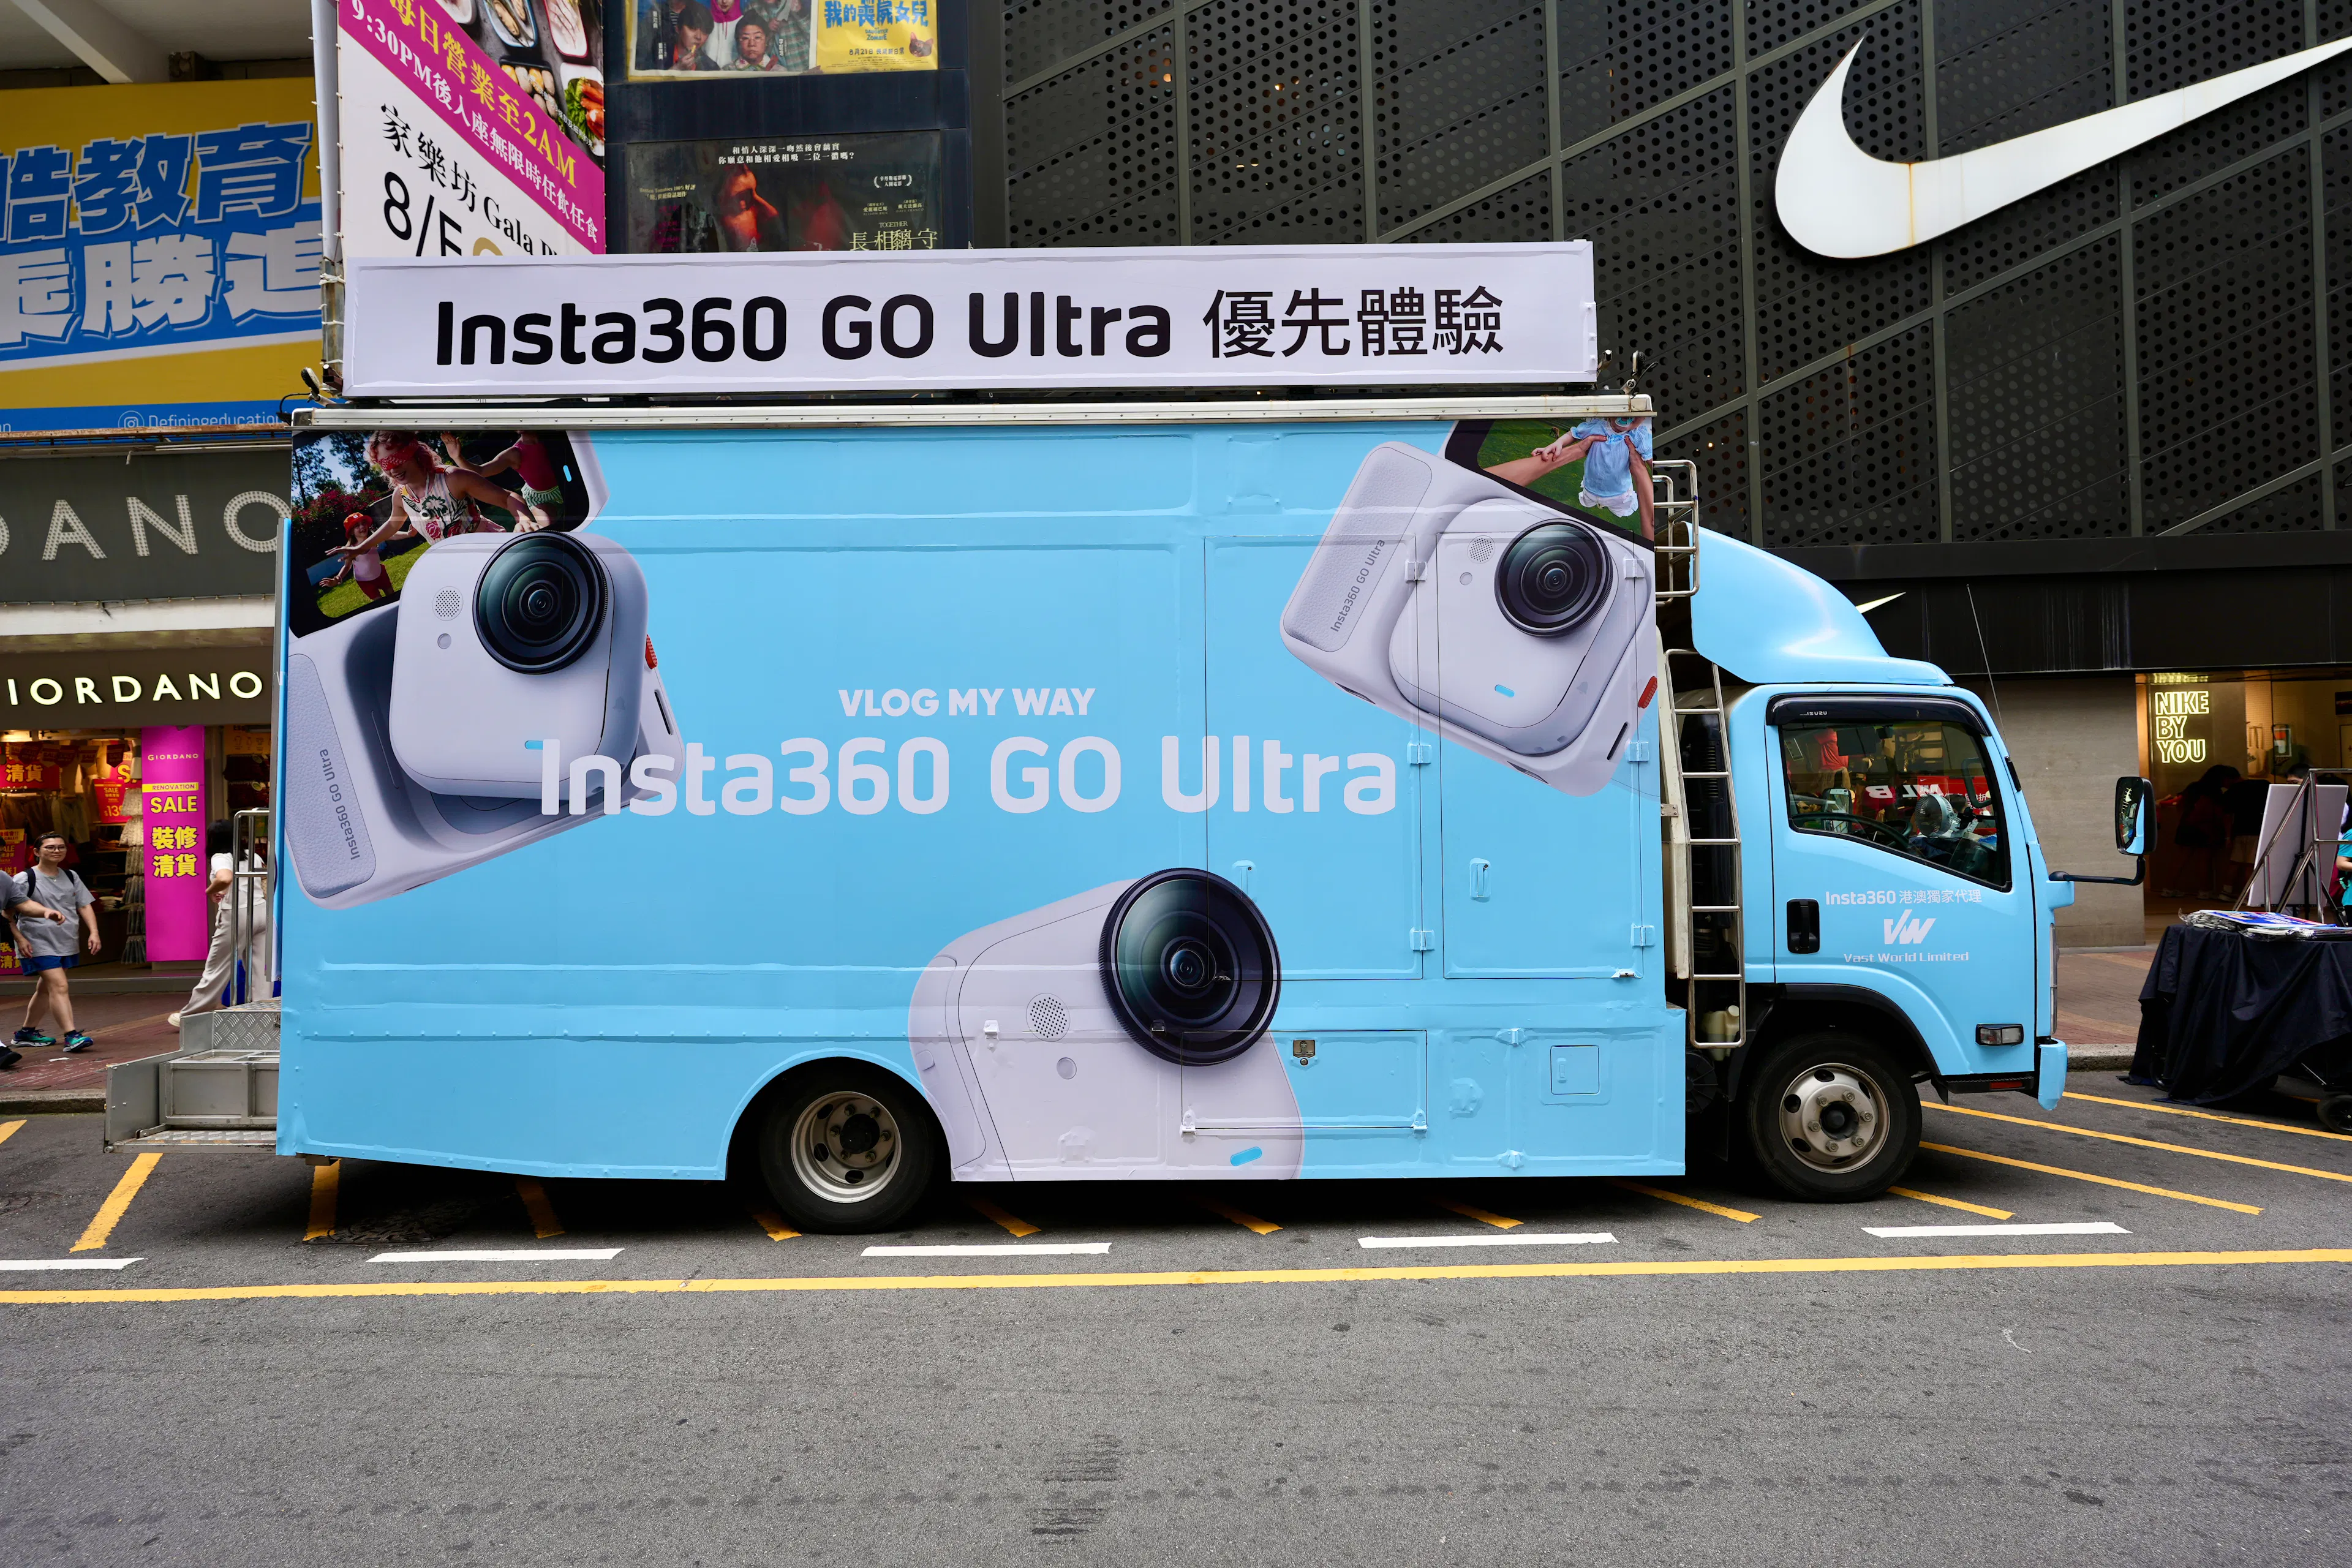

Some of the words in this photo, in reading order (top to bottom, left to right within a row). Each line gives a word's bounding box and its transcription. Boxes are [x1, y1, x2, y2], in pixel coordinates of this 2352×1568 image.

[824, 0, 929, 28] 我的喪屍女兒
[381, 104, 477, 213] 家樂坊
[484, 197, 533, 255] Gala
[437, 296, 786, 366] Insta360
[822, 294, 933, 360] GO
[969, 291, 1170, 358] Ultra
[1202, 285, 1504, 359] 優先體驗
[149, 412, 281, 427] Definingeducatio
[0, 491, 291, 560] ANO
[1330, 586, 1360, 632] Insta360
[1356, 568, 1370, 584] GO
[1365, 540, 1385, 566] Ultra
[8, 672, 263, 706] IORDANO
[839, 688, 940, 717] VLOG
[949, 688, 1005, 716] MY
[1012, 688, 1096, 715] WAY
[2154, 690, 2210, 715] NIKE
[2155, 715, 2188, 740] BY
[2155, 739, 2207, 764] YOU
[6, 764, 43, 783] 清貨
[320, 748, 336, 782] Ultra
[541, 736, 949, 816] Insta360
[990, 736, 1121, 814] GO
[1161, 735, 1396, 815] Ultra
[150, 796, 198, 813] SALE
[329, 783, 342, 802] GO
[151, 826, 198, 850] 裝修
[336, 805, 361, 861] Insta360
[153, 853, 199, 878] 清貨
[1825, 890, 1896, 905] Insta360
[1899, 889, 1983, 904] 港澳獨家代理
[1844, 953, 1875, 963] Vast
[1877, 952, 1917, 962] World
[1919, 951, 1969, 962] Limited
